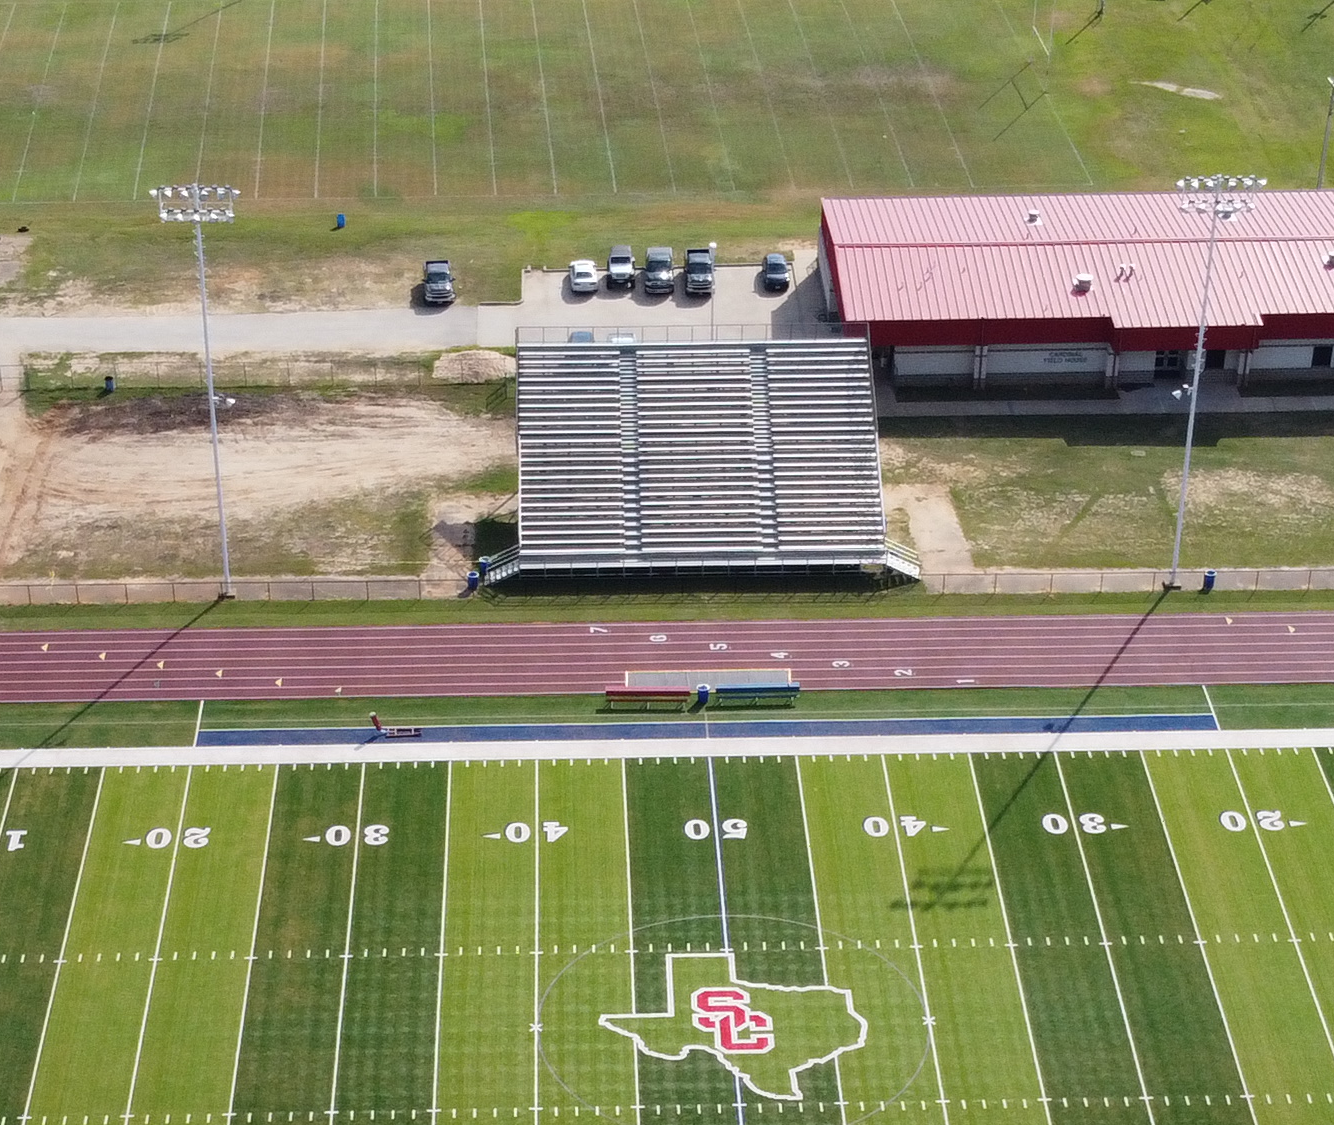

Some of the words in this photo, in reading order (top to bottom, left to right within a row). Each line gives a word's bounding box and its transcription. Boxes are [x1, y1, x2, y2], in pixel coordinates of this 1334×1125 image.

[589, 626, 608, 634] 7
[649, 634, 668, 642] 6
[709, 643, 728, 651] 5
[770, 651, 789, 659] 4
[831, 660, 851, 668] 3
[894, 668, 913, 677] 2
[684, 819, 748, 840] 50
[864, 816, 927, 838] 40
[1042, 813, 1108, 835] 30
[1220, 810, 1287, 832] 20
[146, 827, 212, 849] 20
[325, 825, 389, 847] 30
[505, 822, 568, 844] 40
[691, 987, 774, 1054] SC
